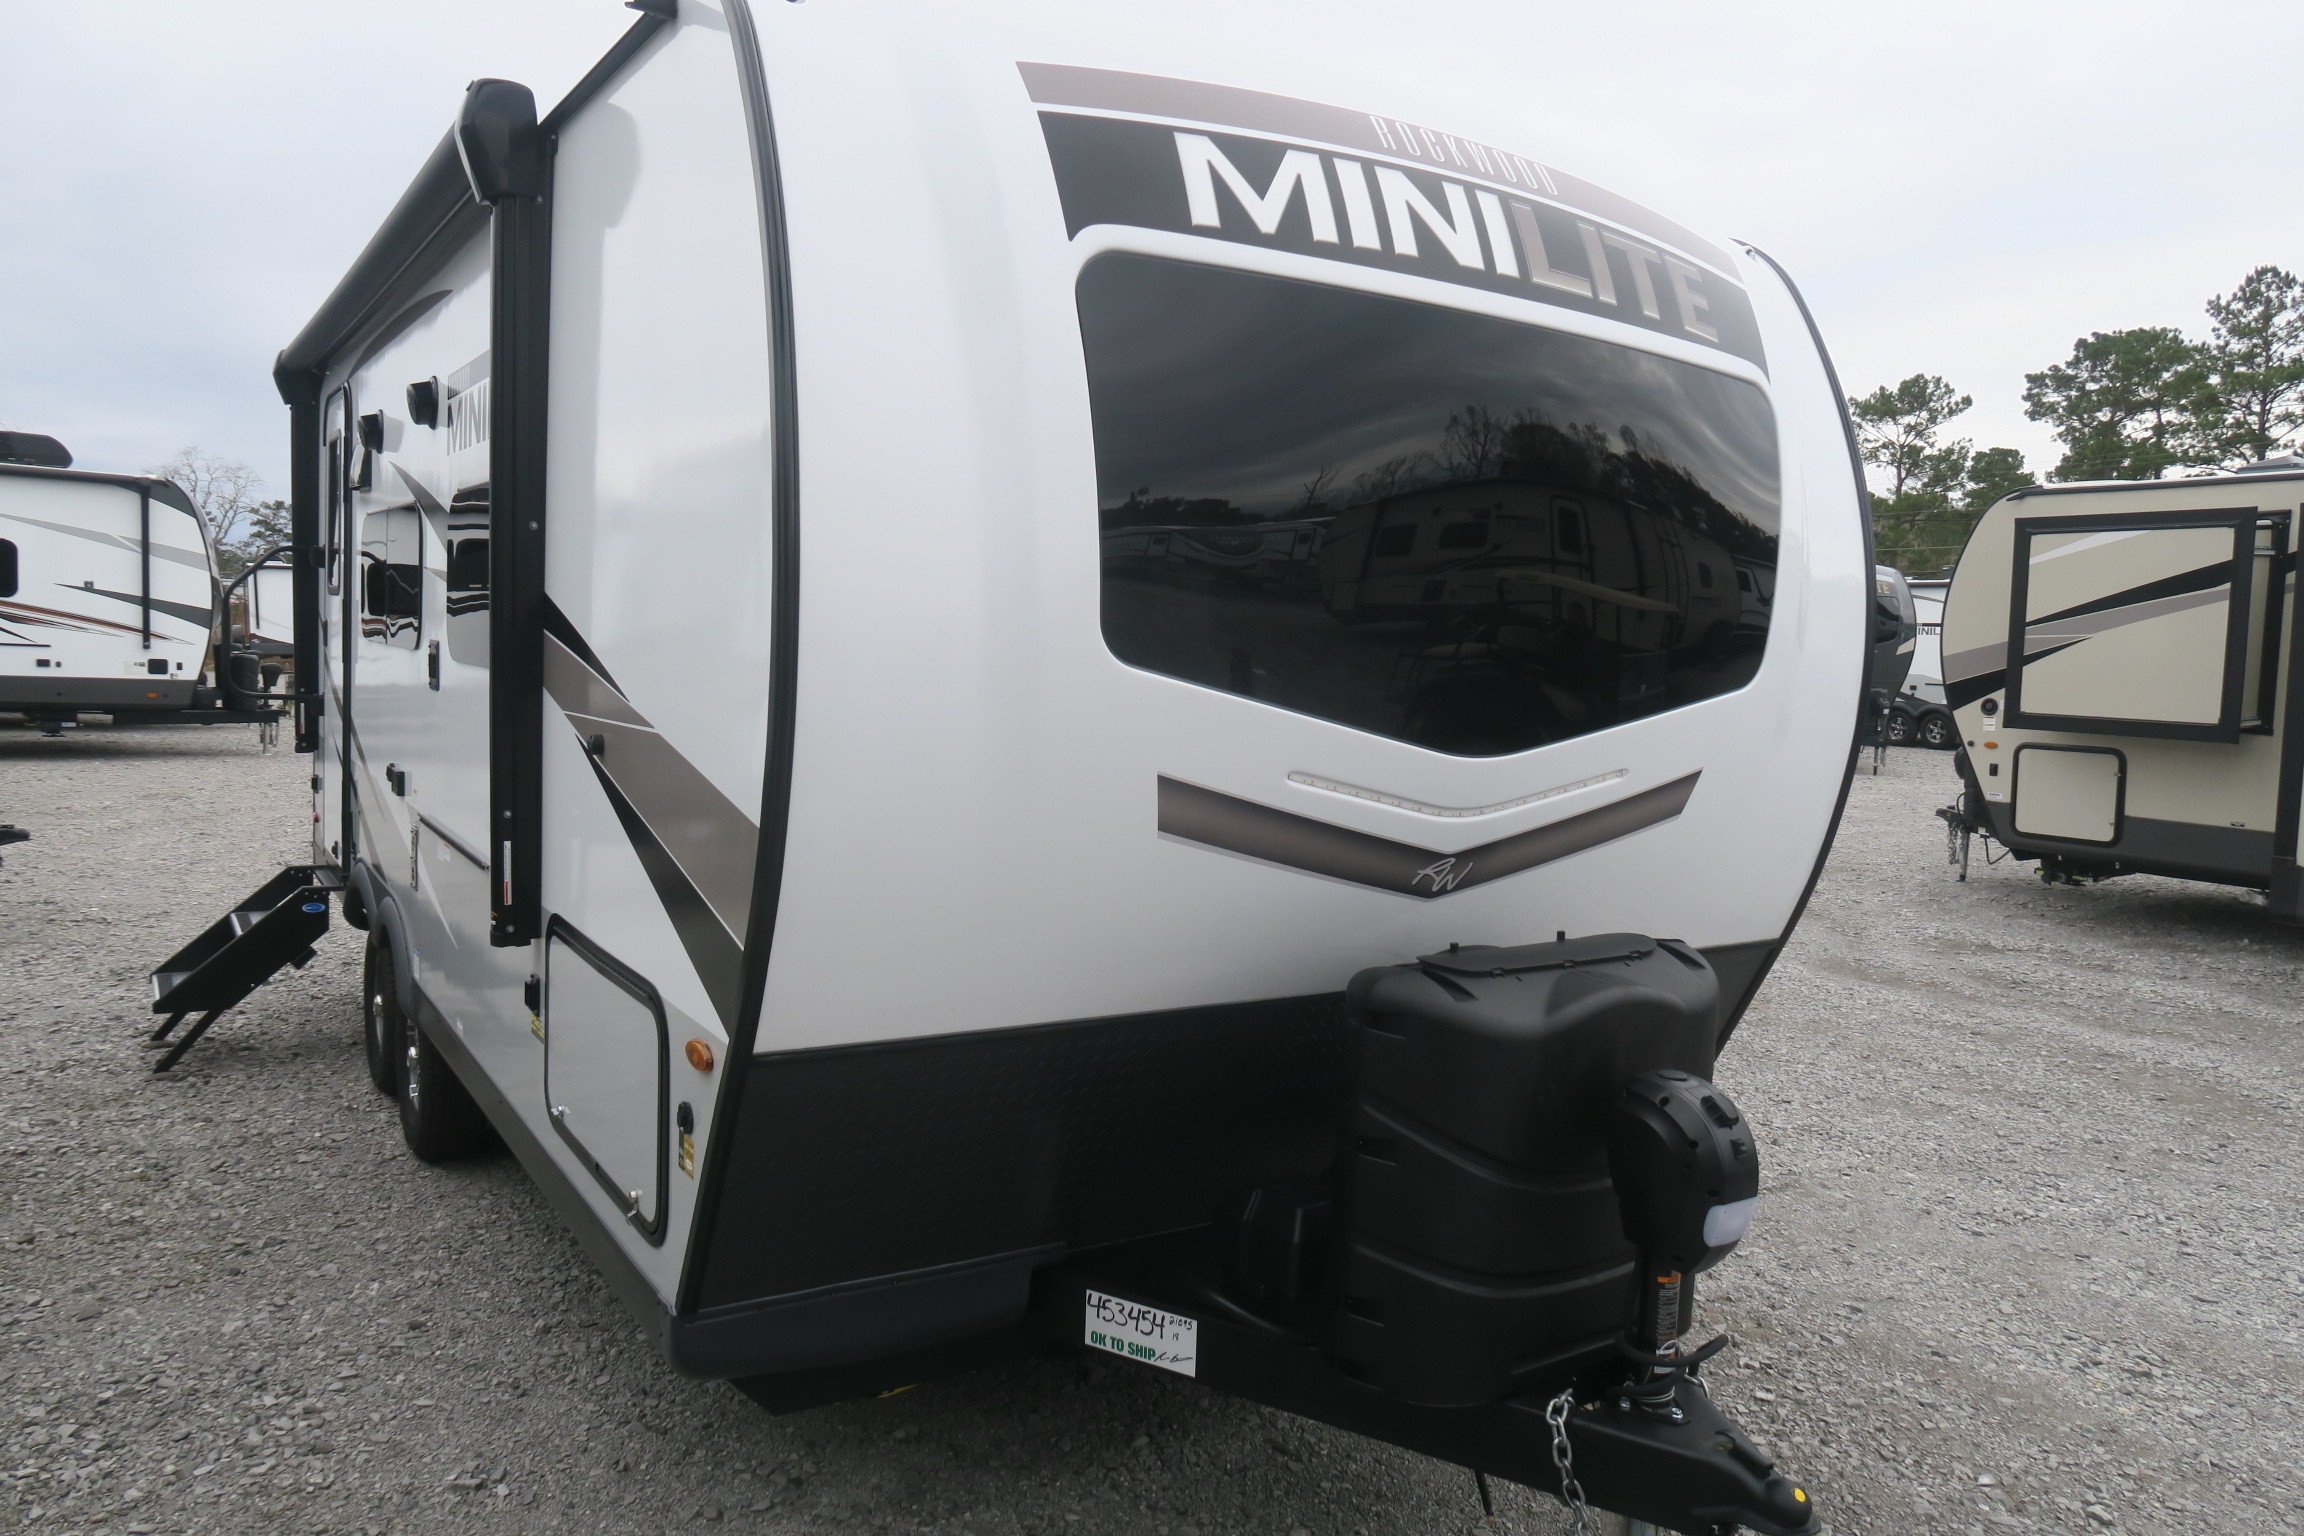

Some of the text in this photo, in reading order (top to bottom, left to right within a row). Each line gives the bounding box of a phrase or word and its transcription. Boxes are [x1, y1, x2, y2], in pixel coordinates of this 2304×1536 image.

[1369, 114, 1560, 196] ROCKWOOD
[1086, 1292, 1165, 1340] 453454
[1090, 1330, 1108, 1347] OK
[1109, 1336, 1125, 1352] TO
[1127, 1341, 1156, 1361] SHIP
